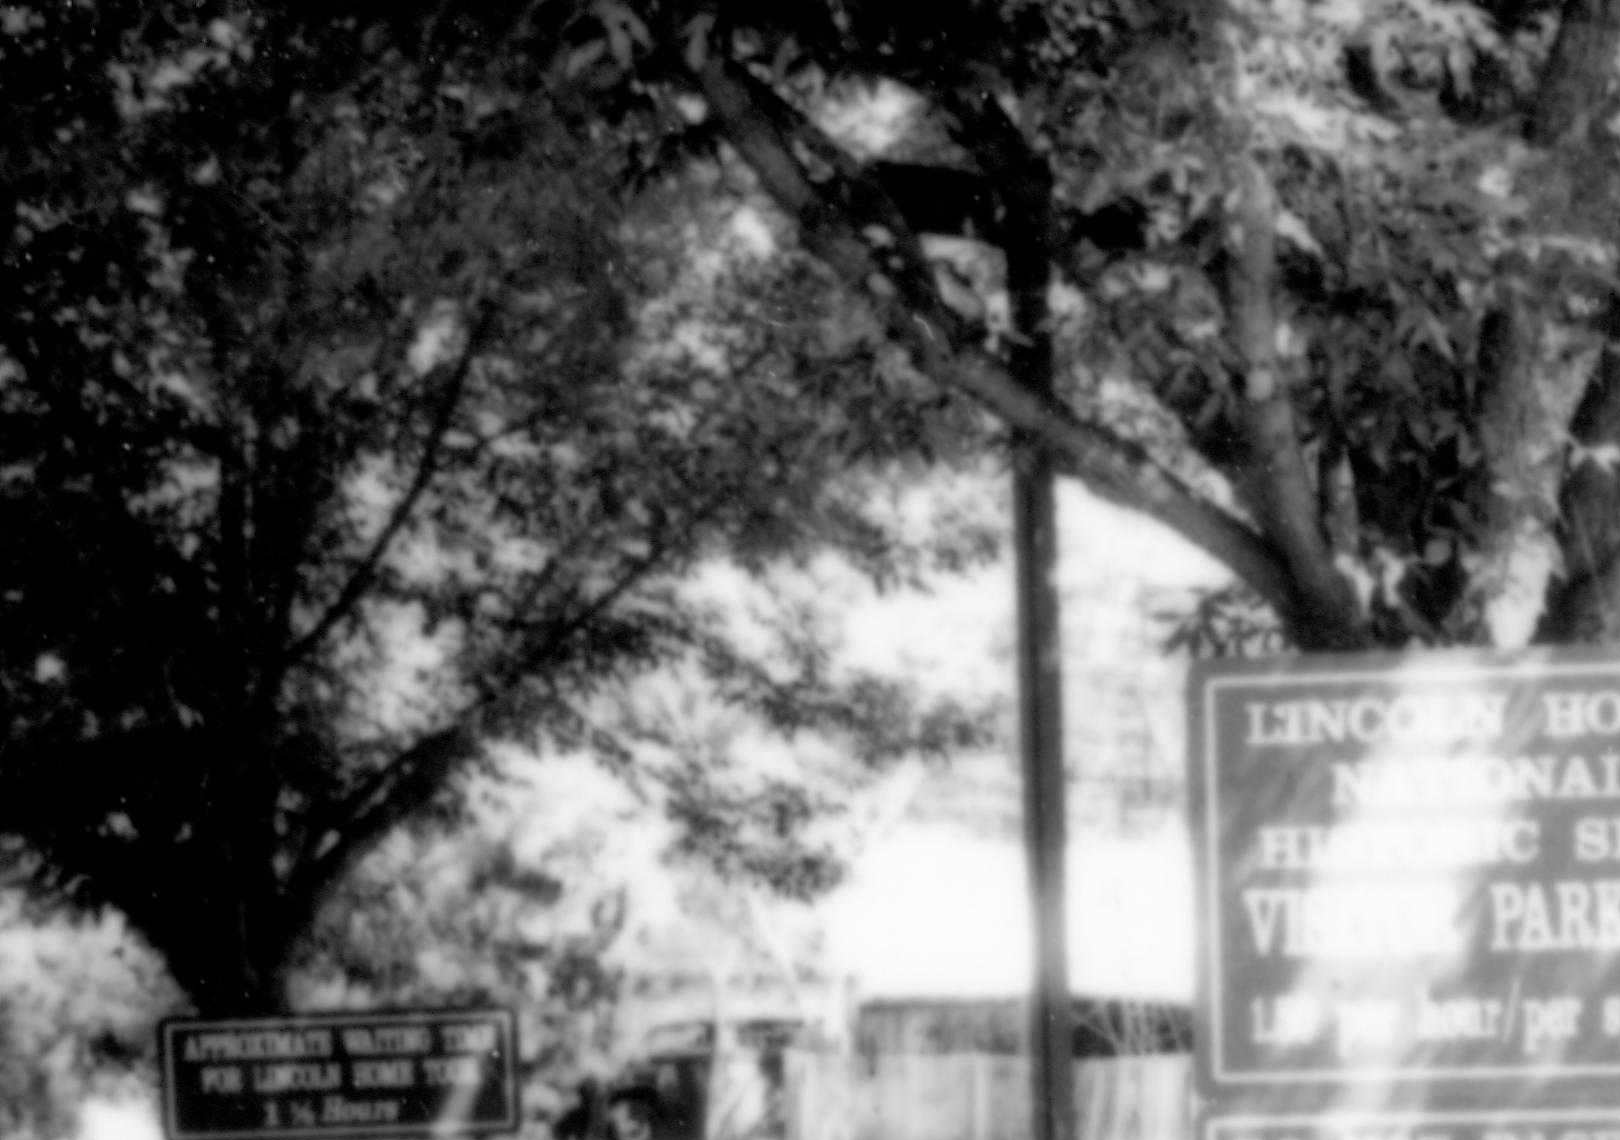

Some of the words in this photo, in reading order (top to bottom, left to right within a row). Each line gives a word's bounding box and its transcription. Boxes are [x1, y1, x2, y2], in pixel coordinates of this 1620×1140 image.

[1245, 692, 1508, 746] LINCOLN
[1257, 817, 1540, 870] HIIC
[1242, 887, 1463, 958] VISR
[201, 1067, 243, 1093] FOR
[254, 1063, 342, 1091] LINCOLN
[354, 1060, 415, 1087] HOME
[322, 1094, 400, 1121] Hours
